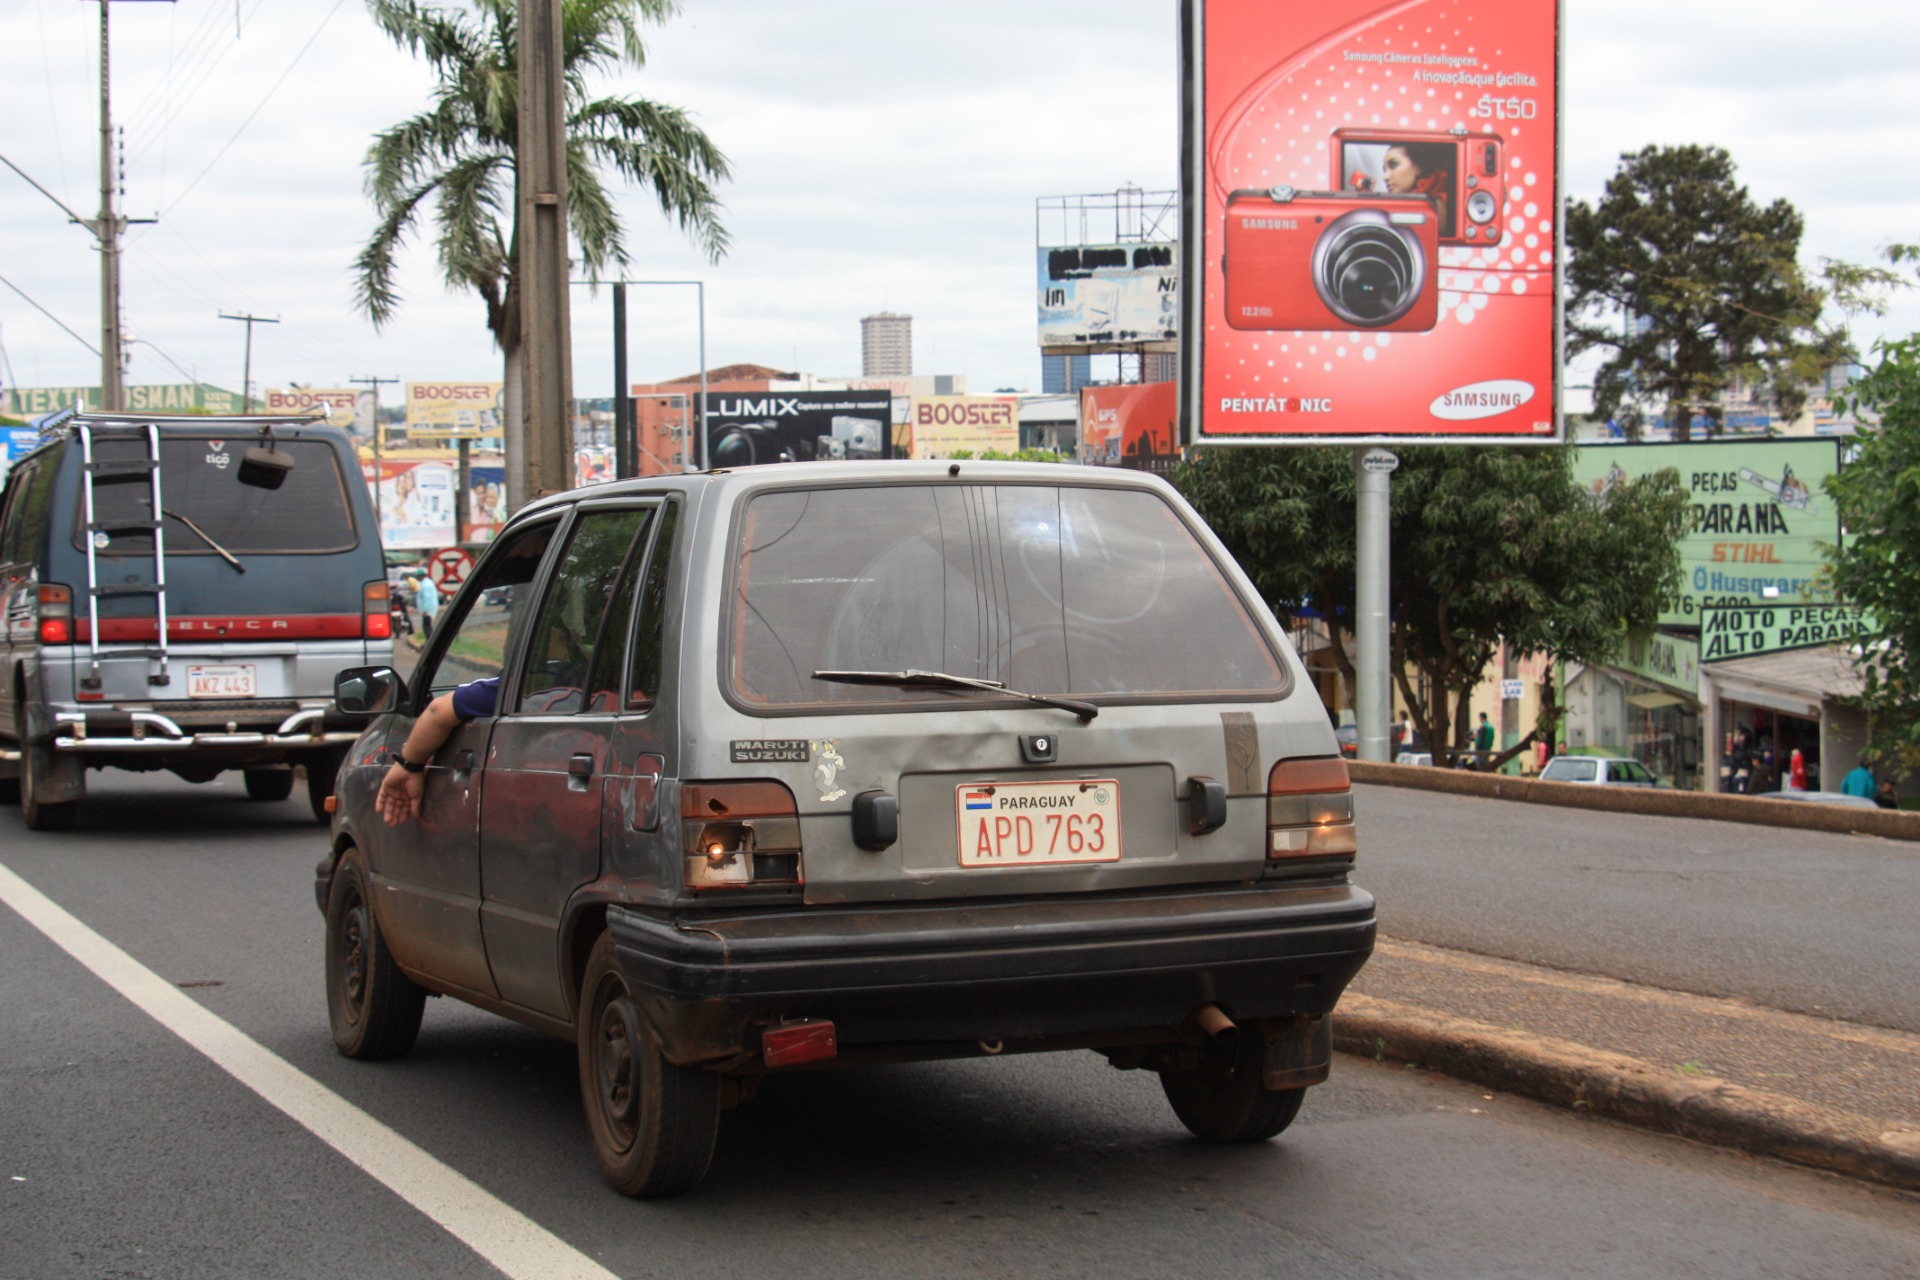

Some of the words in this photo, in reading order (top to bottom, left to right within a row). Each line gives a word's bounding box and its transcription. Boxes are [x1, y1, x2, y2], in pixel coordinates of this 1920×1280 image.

[1343, 50, 1382, 64] Samsung
[1384, 52, 1421, 64] Câmeras
[1413, 71, 1420, 82] A
[1473, 76, 1494, 88] que
[1477, 99, 1536, 119] ST50
[1242, 218, 1297, 230] SAMSUNG
[270, 393, 355, 408] BOOSTER
[414, 386, 490, 400] BOOSTER
[1444, 393, 1521, 407] SAMSUNG
[918, 403, 1012, 425] BOOSTER
[1692, 472, 1737, 495] PEÇAS
[1712, 542, 1782, 564] STIHL
[1705, 610, 1775, 633] MOTO
[1790, 606, 1864, 626] PEÇAS
[1705, 630, 1765, 658] ALTO
[194, 677, 220, 694] AKZ
[224, 676, 250, 693] 443
[735, 741, 805, 750] MARUTI
[736, 751, 806, 760] SUZUKI
[1000, 795, 1076, 810] PARAGUAY
[976, 815, 1033, 858] APD
[1046, 812, 1105, 854] 763
